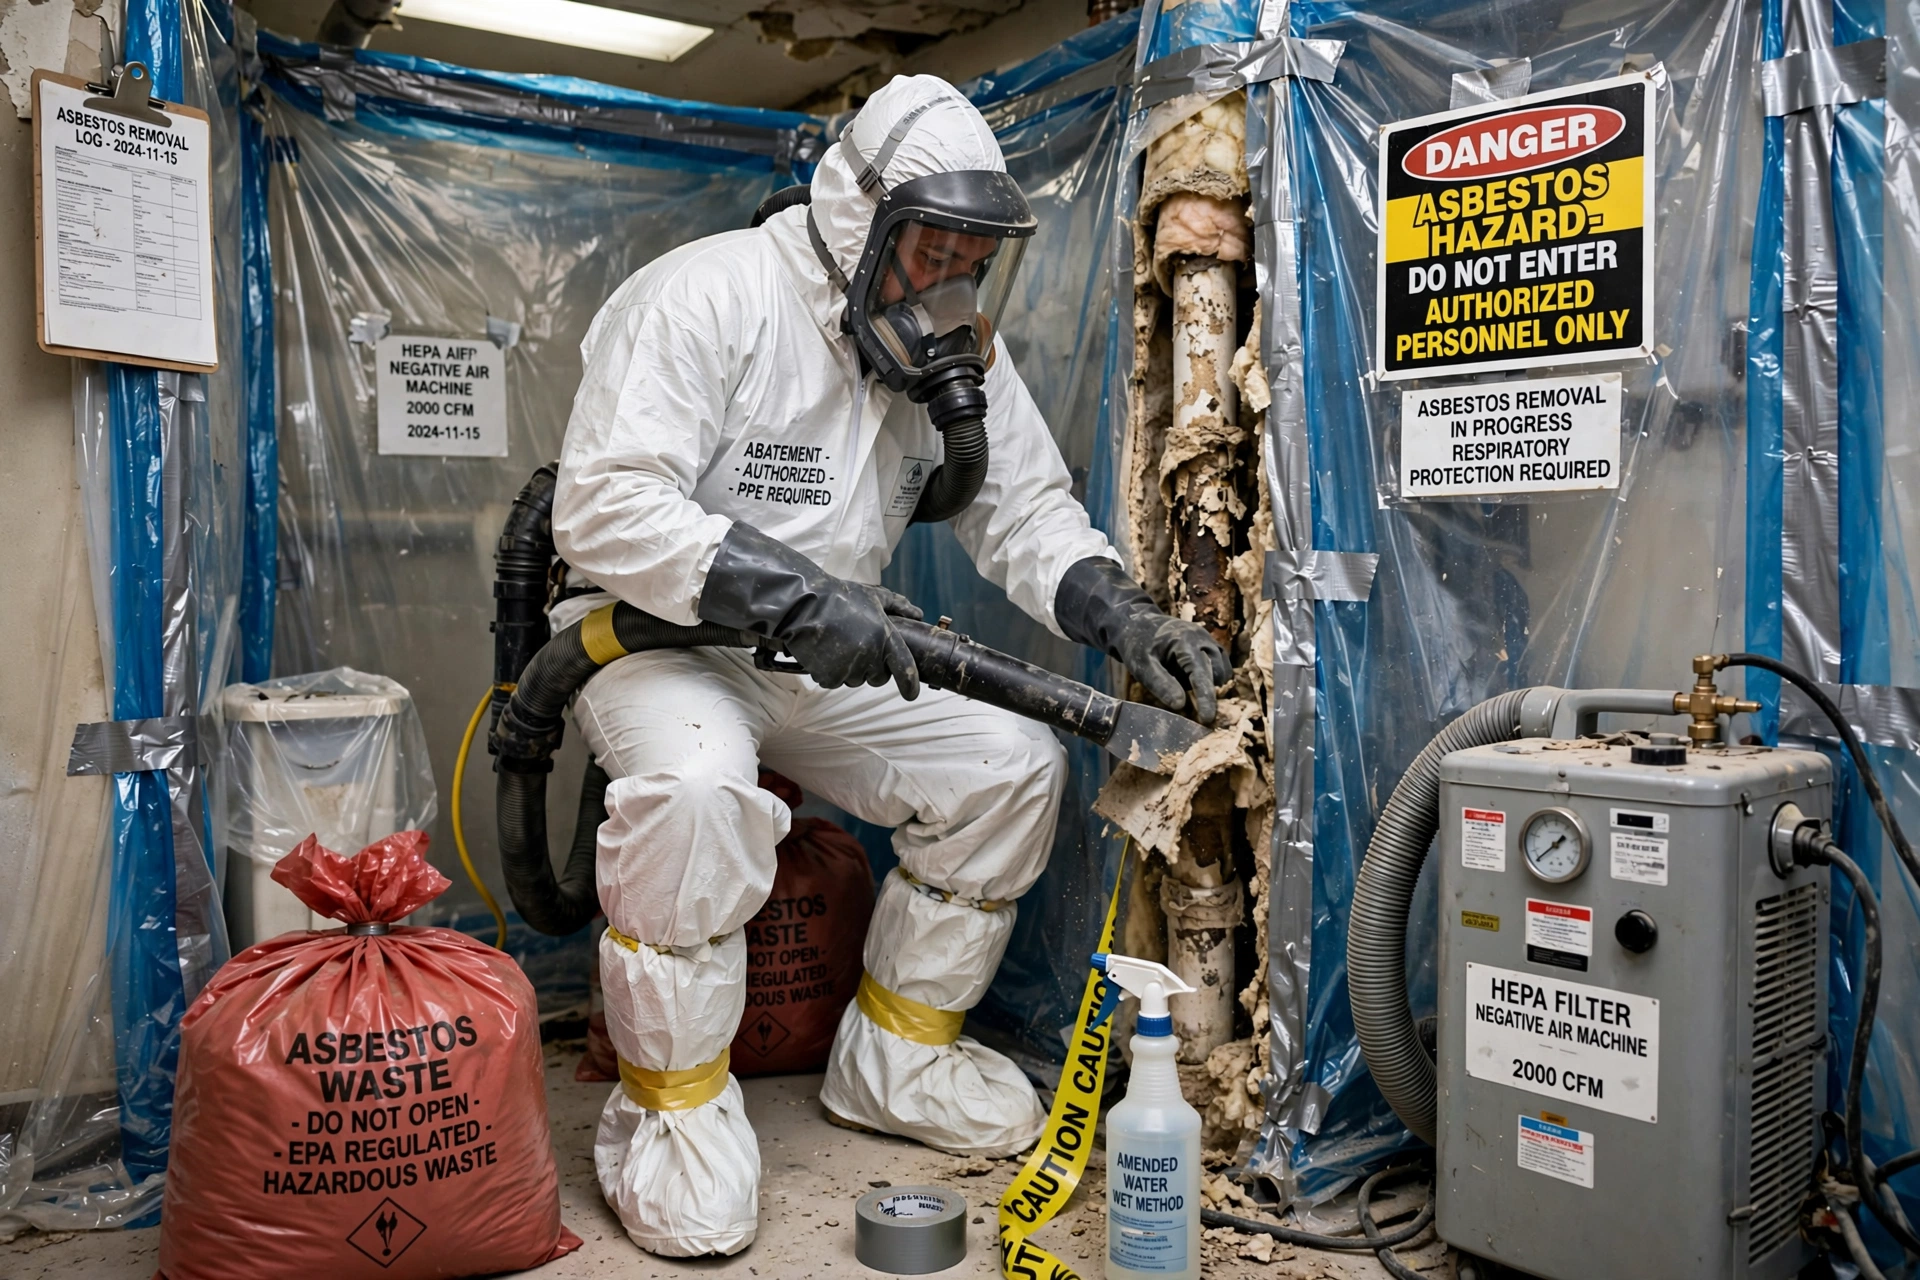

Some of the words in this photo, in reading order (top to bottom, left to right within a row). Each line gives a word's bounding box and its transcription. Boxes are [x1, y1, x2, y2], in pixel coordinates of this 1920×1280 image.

[57, 106, 125, 136] ASBESTOS
[129, 124, 189, 151] REMOVAL
[75, 129, 103, 148] LOG
[113, 141, 178, 165] 2024-11-15
[1425, 113, 1598, 175] DANGER
[1415, 163, 1609, 227] ASBESTOS
[1408, 263, 1447, 295] DO
[1454, 254, 1512, 289] NOT
[1519, 239, 1618, 281] ENTER
[1425, 279, 1595, 326] AUTHORIZED
[1396, 318, 1548, 361] PERSONNEL
[1555, 308, 1630, 345] ONLY
[402, 344, 441, 359] HEPA
[390, 361, 462, 378] NEGATIVE
[466, 365, 489, 379] AIR
[406, 380, 473, 396] MACHINE
[1417, 393, 1510, 418] ASBESTOS
[1516, 385, 1607, 410] REMOVAL
[407, 401, 440, 415] 2000
[444, 403, 474, 417] CFM
[407, 425, 480, 440] 2024-11-15
[1450, 420, 1467, 438] IN
[1472, 412, 1572, 437] PROGRESS
[744, 441, 822, 463] ABATEMENT
[1452, 437, 1571, 462] RESPIRATORY
[742, 462, 826, 484] AUTHORIZED
[1410, 464, 1514, 486] PROTECTION
[1519, 459, 1611, 481] REQUIRED
[737, 482, 764, 500] PPE
[766, 486, 832, 506] REQUIRED
[749, 922, 808, 947] ASTE
[779, 946, 819, 965] OPEN
[747, 964, 827, 988] EGULATED
[789, 979, 836, 1003] WASTE
[1491, 978, 1547, 1011] HEPA
[1555, 990, 1632, 1029] FILTER
[285, 1015, 478, 1065] ASBESTOS
[1475, 1003, 1544, 1035] NEGATIVE
[1547, 1019, 1573, 1041] AIR
[1577, 1025, 1648, 1058] MACHINE
[319, 1058, 452, 1103] WASTE
[1512, 1059, 1557, 1086] 2000
[1562, 1071, 1604, 1099] CFM
[307, 1110, 343, 1135] DO
[351, 1106, 401, 1133] NOT
[408, 1092, 469, 1126] OPEN
[288, 1141, 336, 1165] EPA
[345, 1119, 480, 1164] REGULATED
[263, 1163, 418, 1195] HAZARDOUS
[424, 1141, 498, 1182] WASTE
[1010, 1101, 1090, 1223] CAUTION
[1117, 1152, 1178, 1172] AMENDED
[1123, 1173, 1168, 1193] WATER
[1112, 1189, 1134, 1209] WET
[1135, 1195, 1184, 1212] METHOD
